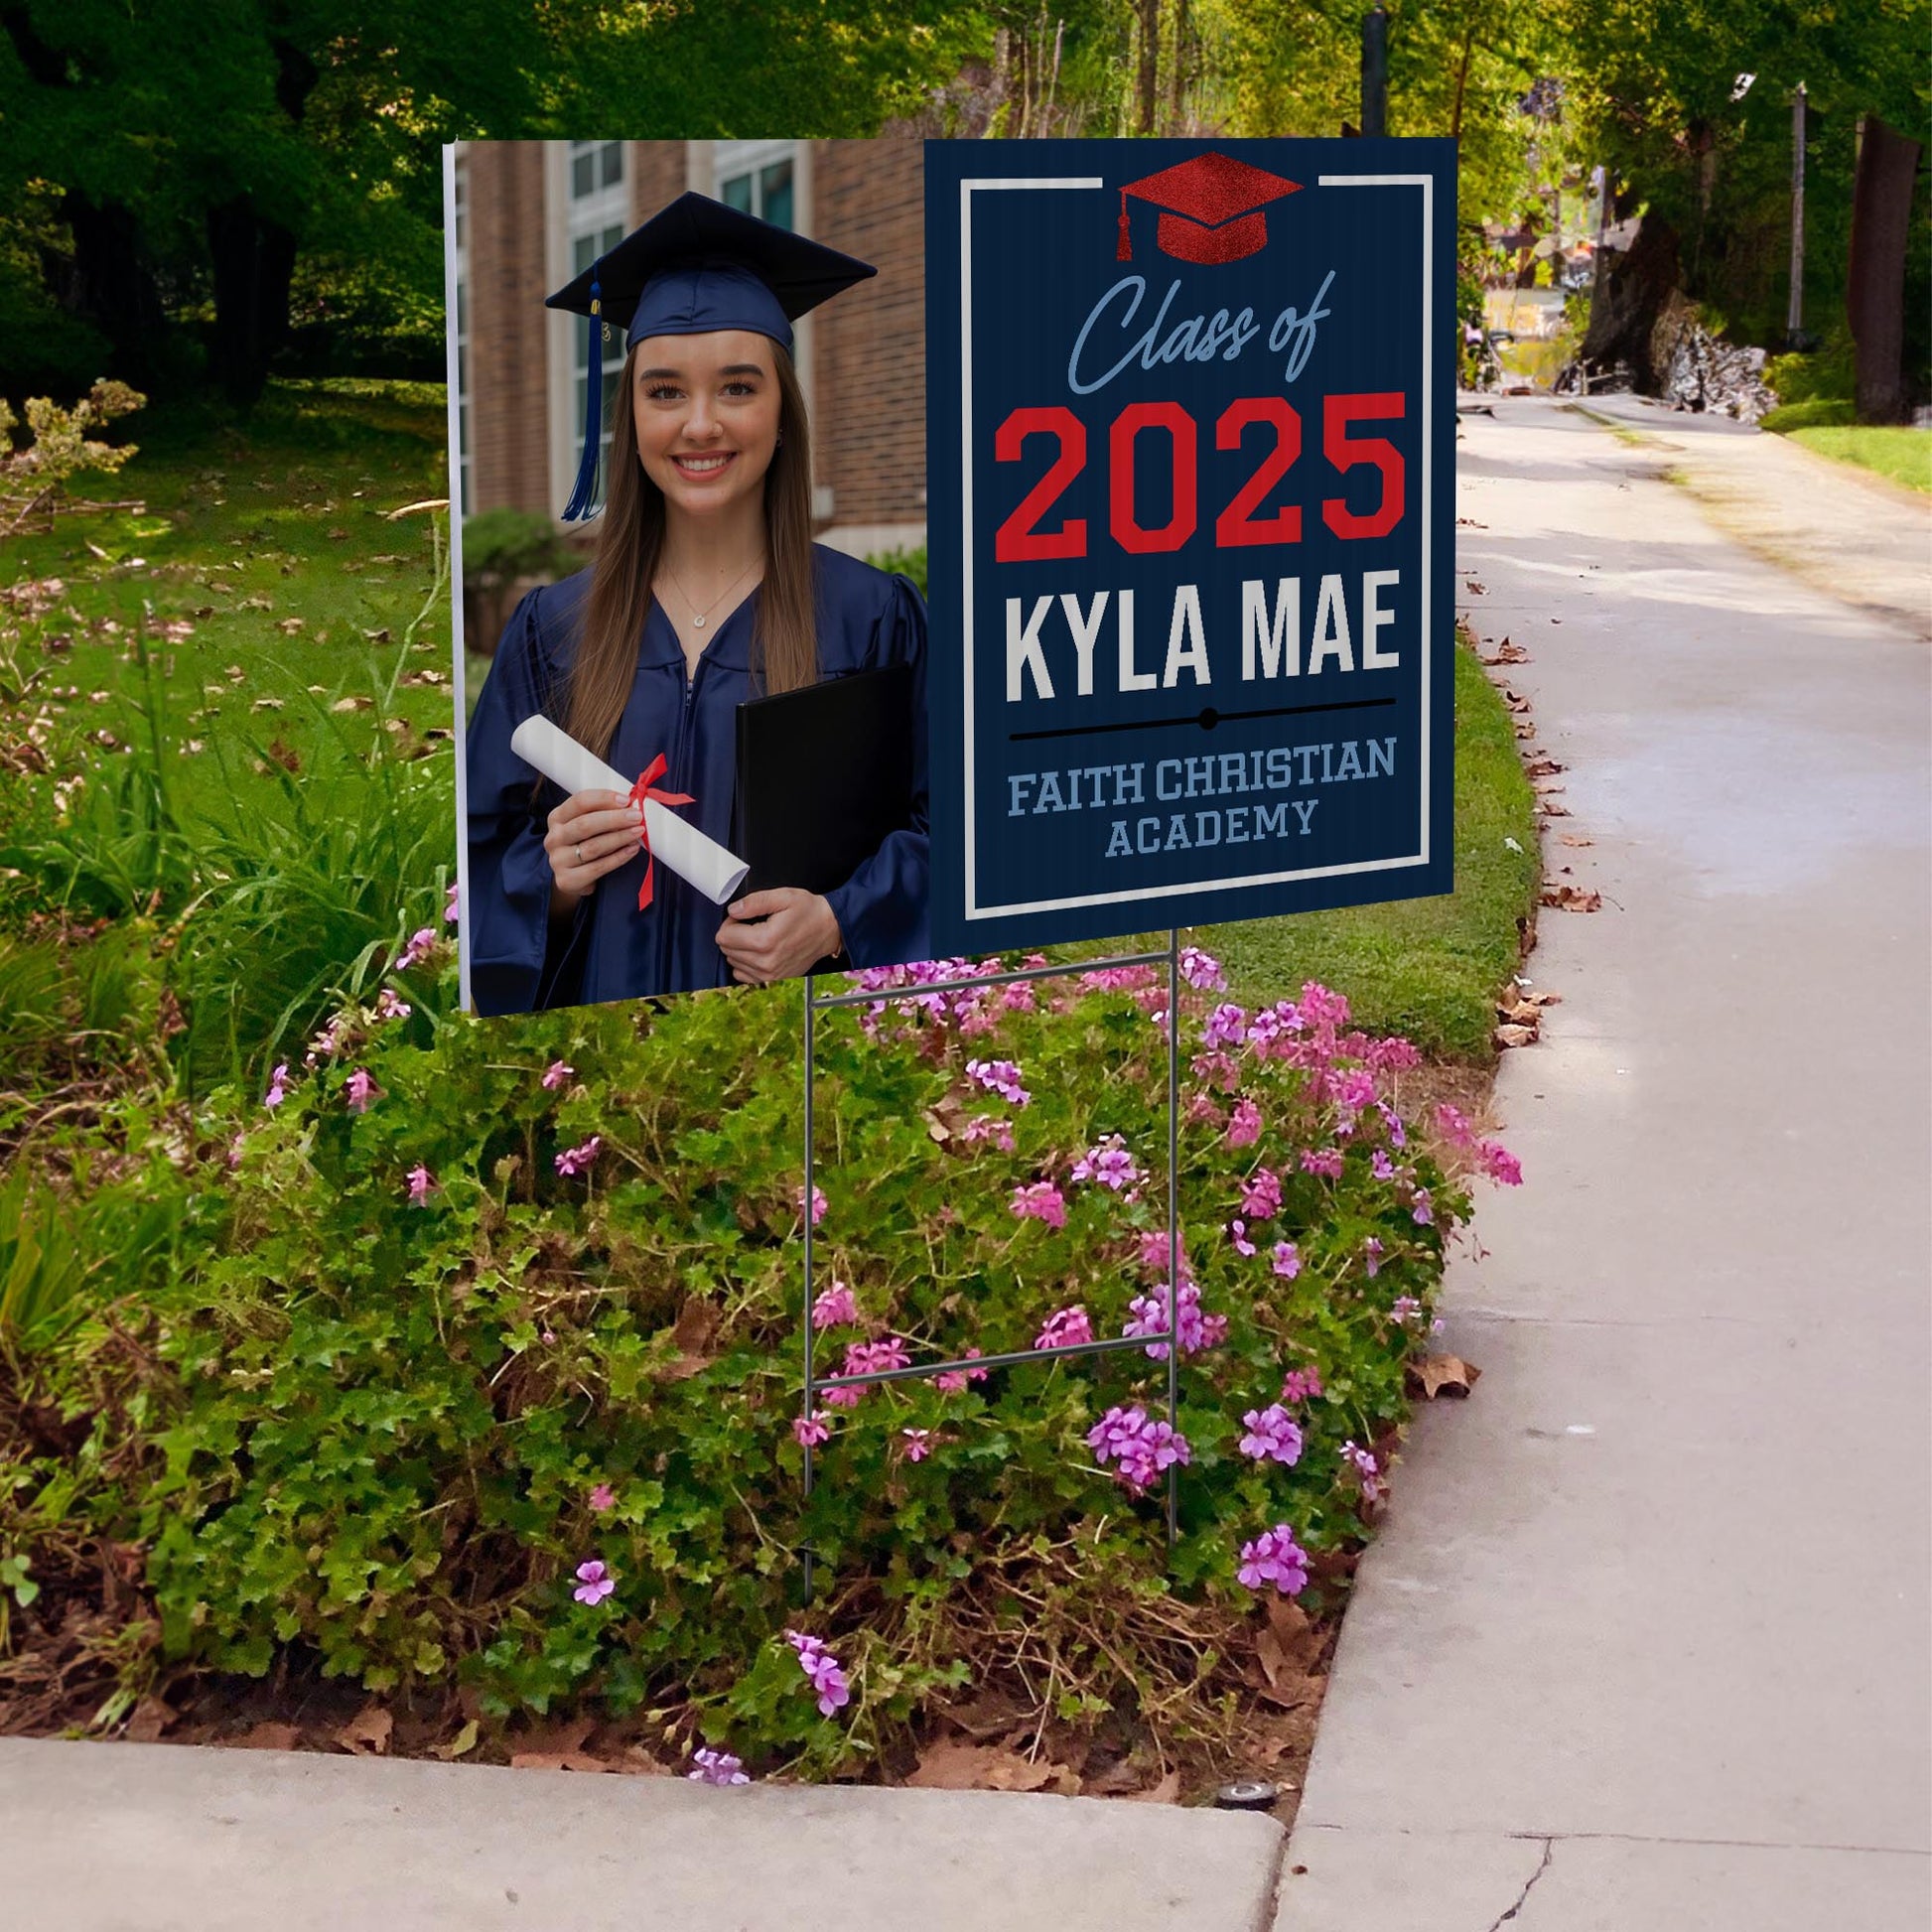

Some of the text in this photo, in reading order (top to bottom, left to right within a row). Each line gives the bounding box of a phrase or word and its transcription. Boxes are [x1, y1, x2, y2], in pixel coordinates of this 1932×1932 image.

[1067, 269, 1336, 395] Class of
[995, 391, 1406, 563] 2025
[1005, 569, 1401, 703] KYLA MAE
[1007, 736, 1398, 817] FAITH CHRISTIAN
[1104, 799, 1319, 858] ACADEMY
